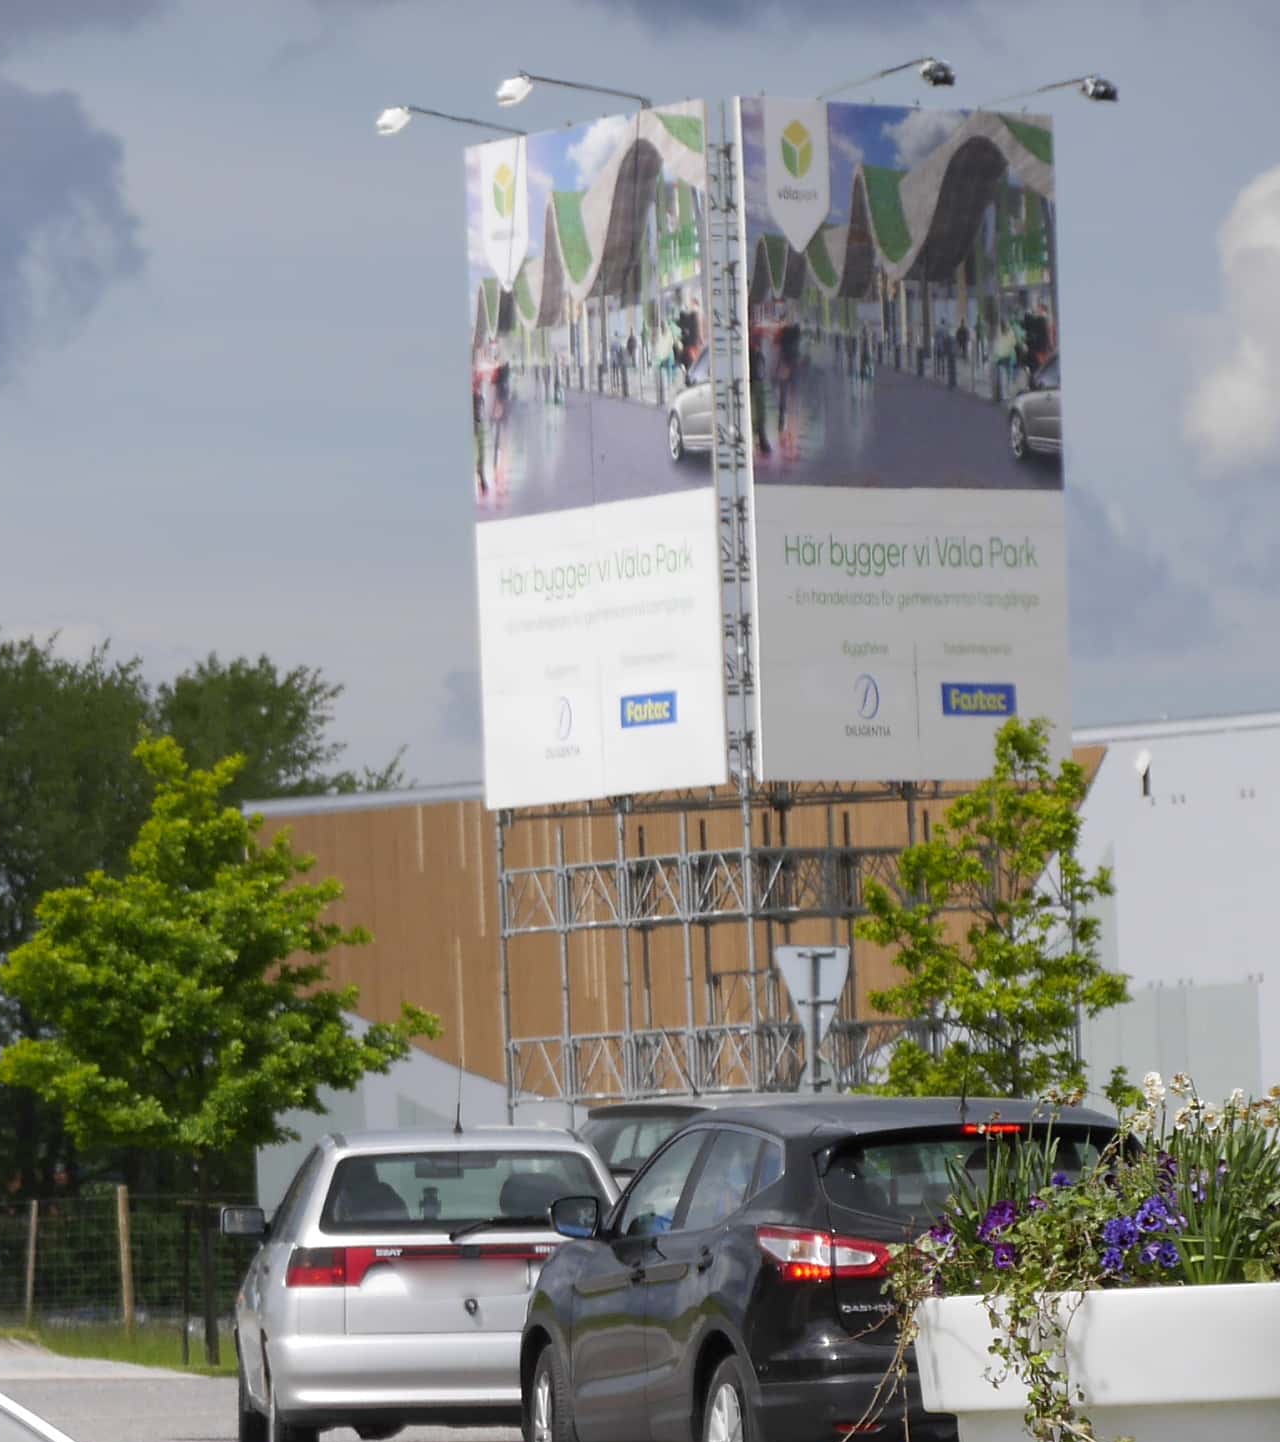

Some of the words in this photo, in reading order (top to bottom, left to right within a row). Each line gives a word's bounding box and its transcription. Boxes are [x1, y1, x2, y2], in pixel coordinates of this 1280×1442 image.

[533, 561, 591, 601] bygger
[596, 556, 611, 582] vi
[656, 537, 694, 574] Park
[784, 534, 824, 567] Här
[830, 532, 908, 577] bygger
[913, 535, 930, 567] vi
[936, 535, 983, 568] Väla
[990, 536, 1039, 568] Park
